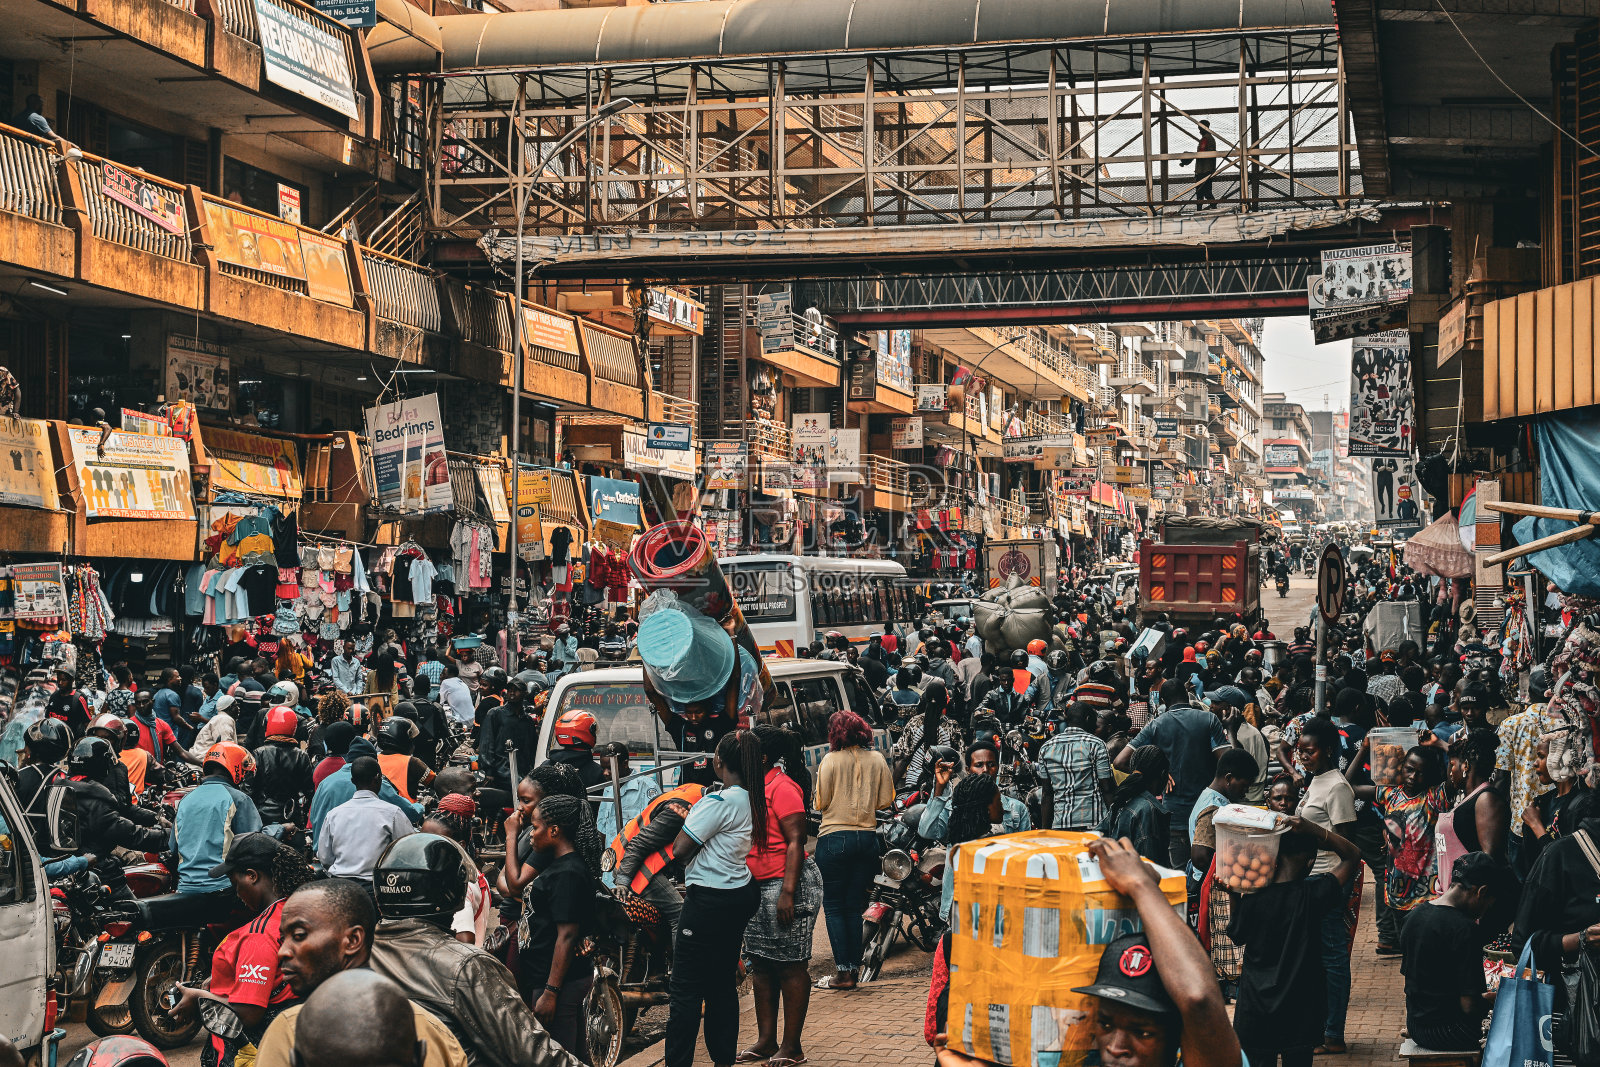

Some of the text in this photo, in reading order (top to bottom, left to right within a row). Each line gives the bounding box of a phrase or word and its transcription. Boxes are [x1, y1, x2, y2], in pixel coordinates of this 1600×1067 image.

[346, 6, 370, 14] BL6-32
[104, 164, 137, 191] CITY
[1324, 248, 1372, 260] MUZUNGU
[375, 420, 434, 442] Beddings
[74, 432, 100, 445] Classi
[759, 602, 768, 610] WILL
[769, 602, 787, 610] PROSPER
